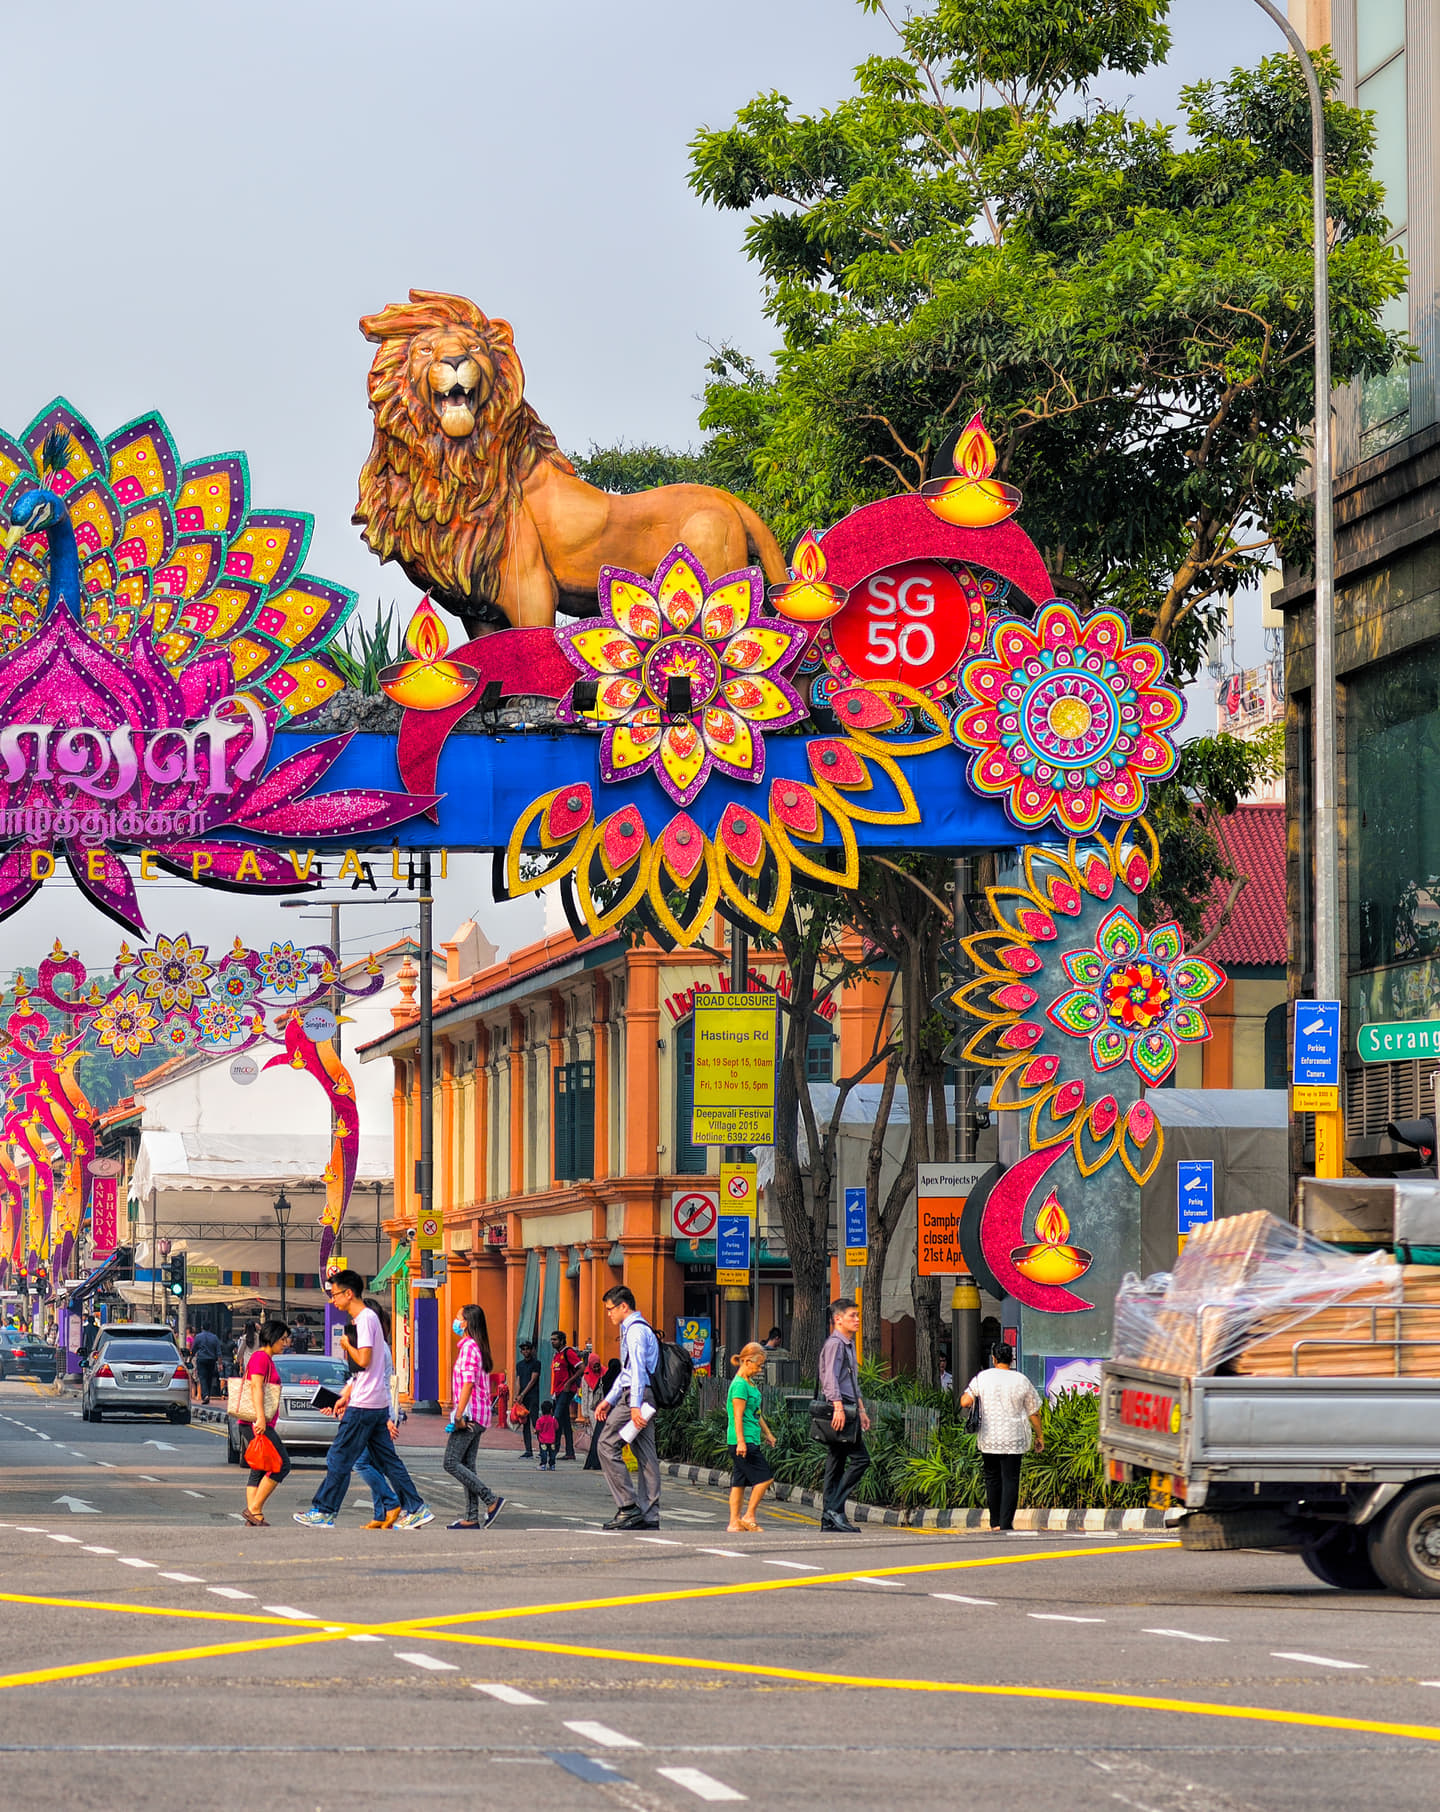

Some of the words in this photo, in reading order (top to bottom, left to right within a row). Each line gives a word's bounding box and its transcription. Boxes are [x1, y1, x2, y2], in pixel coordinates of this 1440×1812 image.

[866, 575, 935, 617] SG
[867, 621, 935, 666] 50
[30, 848, 448, 881] DEEPAVALI
[696, 995, 725, 1006] ROAD
[727, 995, 775, 1006] CLOSURE
[701, 1030, 750, 1043] Hastings
[753, 1030, 769, 1041] Rd
[1307, 1044, 1326, 1054] Parking
[696, 1058, 710, 1068] Sat,
[713, 1058, 721, 1066] 19
[722, 1058, 739, 1068] Sept
[742, 1058, 751, 1068] 15,
[754, 1058, 773, 1066] 10am
[1306, 1070, 1326, 1078] Camera
[700, 1080, 712, 1090] Fri,
[714, 1080, 722, 1088] 13
[724, 1080, 738, 1088] Nov
[741, 1080, 750, 1090] 15,
[752, 1080, 768, 1091] 5pm
[696, 1109, 737, 1119] Deepavali
[739, 1109, 772, 1118] Festival
[708, 1120, 736, 1132] Village
[738, 1120, 758, 1130] 2015
[696, 1132, 726, 1141] Hotline:
[728, 1132, 748, 1142] 6392
[750, 1132, 771, 1142] 2246
[920, 1176, 938, 1186] Apex
[940, 1176, 970, 1186] Projects
[94, 1180, 104, 1236] ANANDA
[104, 1193, 114, 1248] BHAVAN
[924, 1230, 954, 1244] closed
[924, 1248, 944, 1262] 21st
